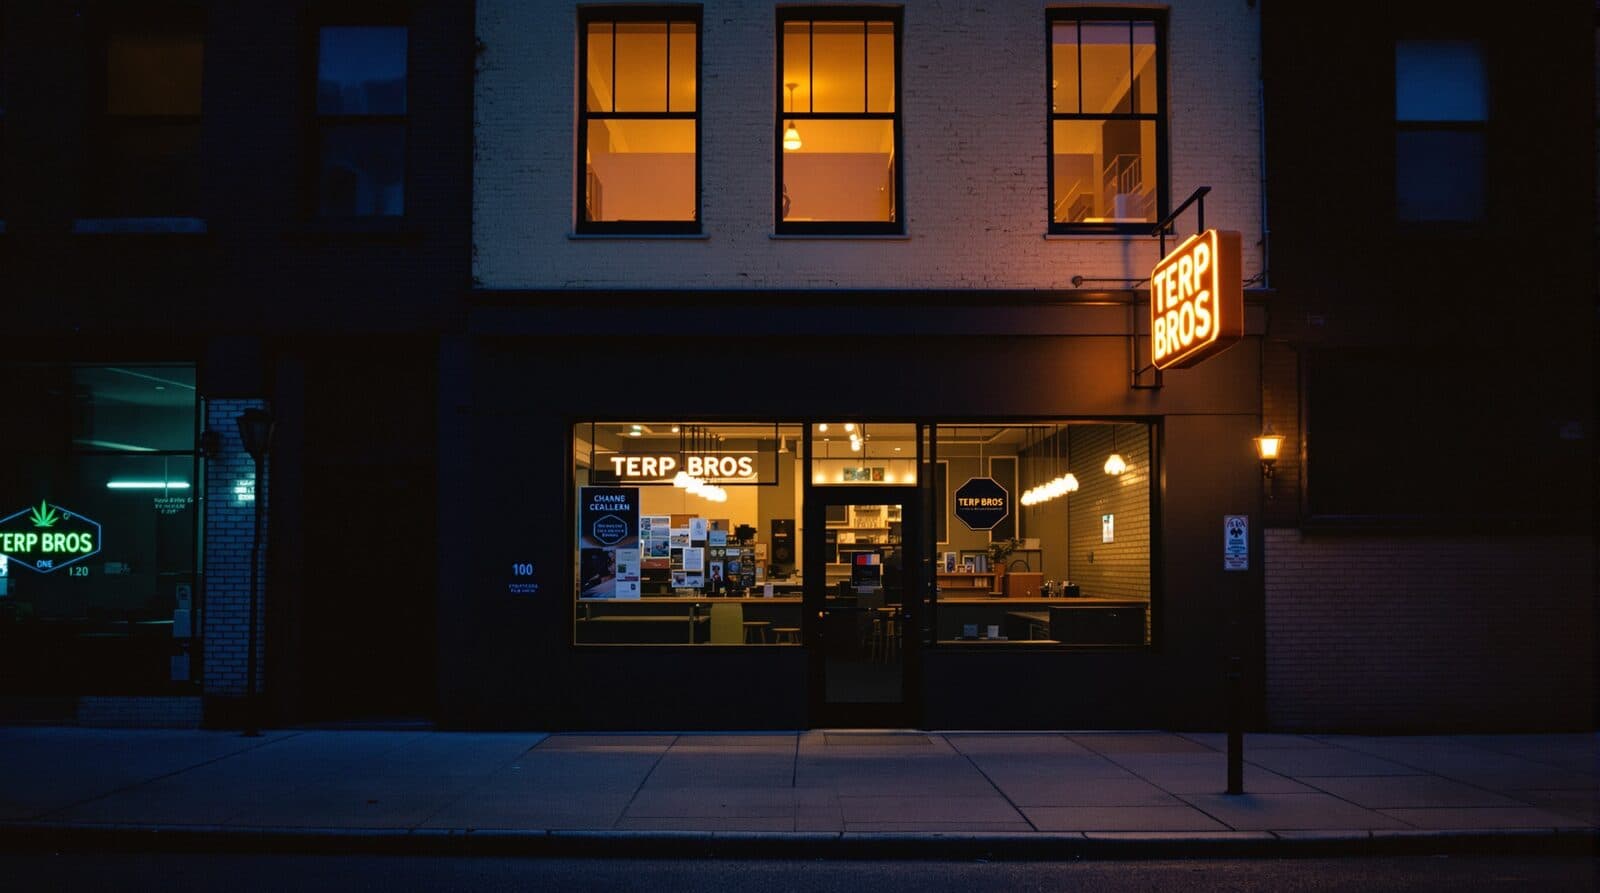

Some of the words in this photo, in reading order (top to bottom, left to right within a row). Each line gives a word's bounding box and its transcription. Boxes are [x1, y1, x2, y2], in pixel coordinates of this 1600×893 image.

[1153, 242, 1210, 314] TERP
[1154, 290, 1212, 360] BROS
[610, 456, 676, 477] TERP
[687, 456, 753, 477] BROS
[958, 497, 980, 506] TERP
[981, 497, 1003, 506] BROS
[41, 532, 93, 553] BROS
[36, 559, 54, 568] ONE
[512, 562, 534, 576] 100
